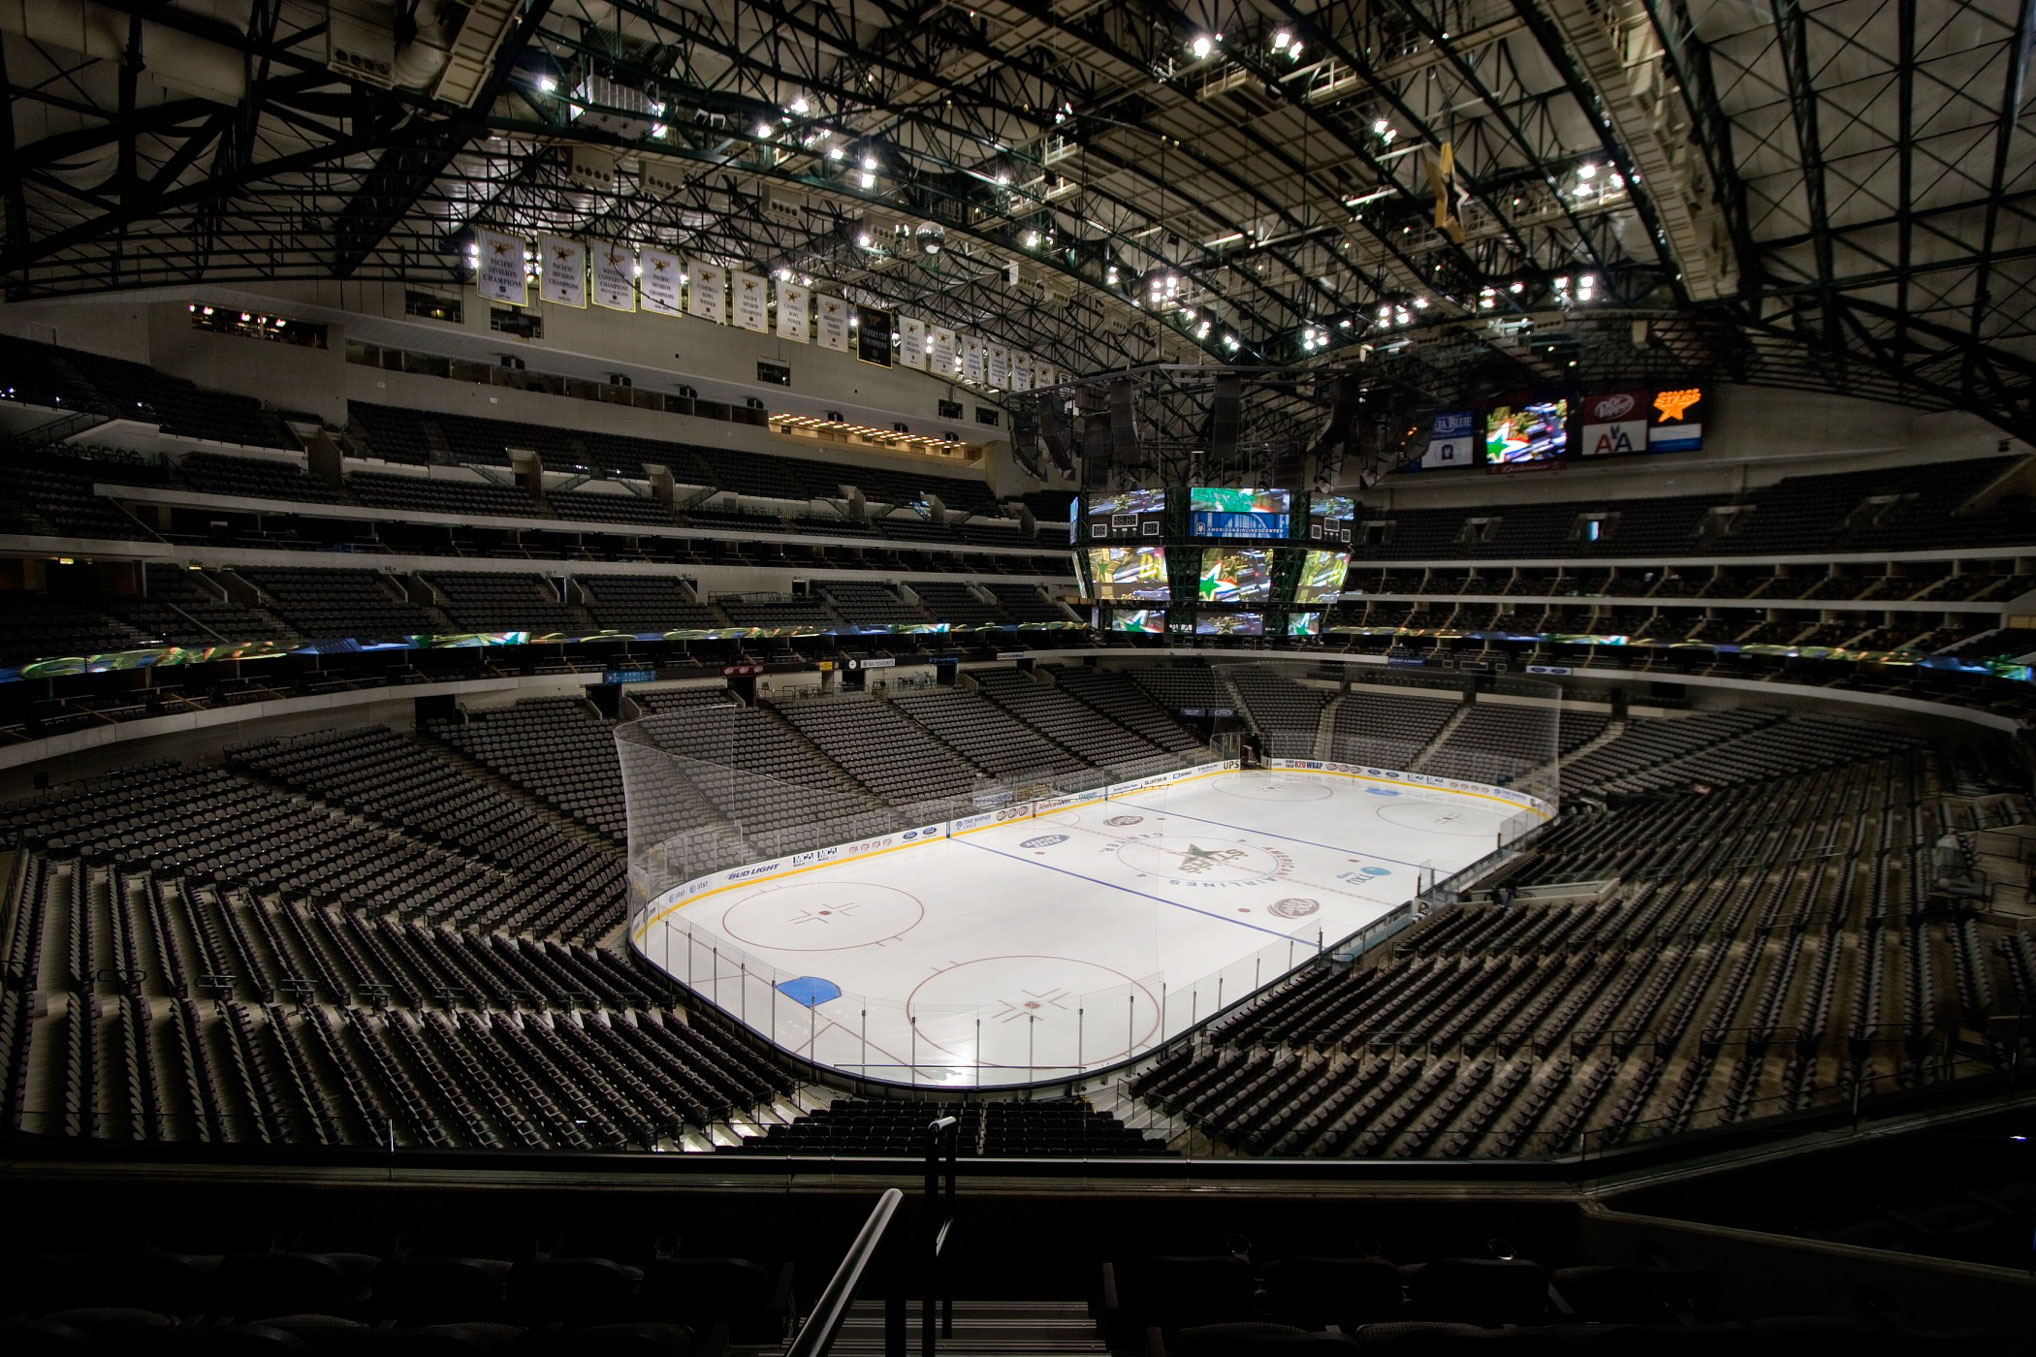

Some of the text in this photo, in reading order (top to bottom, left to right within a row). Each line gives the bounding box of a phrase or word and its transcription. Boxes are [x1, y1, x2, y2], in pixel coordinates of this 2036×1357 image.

[490, 258, 514, 268] PACIFIC
[552, 262, 574, 273] PACIFIC
[488, 266, 517, 278] DIVISION
[552, 270, 575, 281] DIVISION
[483, 274, 522, 288] CHAMPIONS
[548, 279, 579, 290] CHAMPIONS
[1223, 760, 1240, 770] UPS
[964, 814, 992, 825] TIME WARNER
[1178, 848, 1249, 874] STARS
[1261, 845, 1295, 876] AMERICAN
[728, 863, 780, 880] BUD LIGHT
[1169, 876, 1277, 888] AIRLINES
[1346, 873, 1376, 886] TXU
